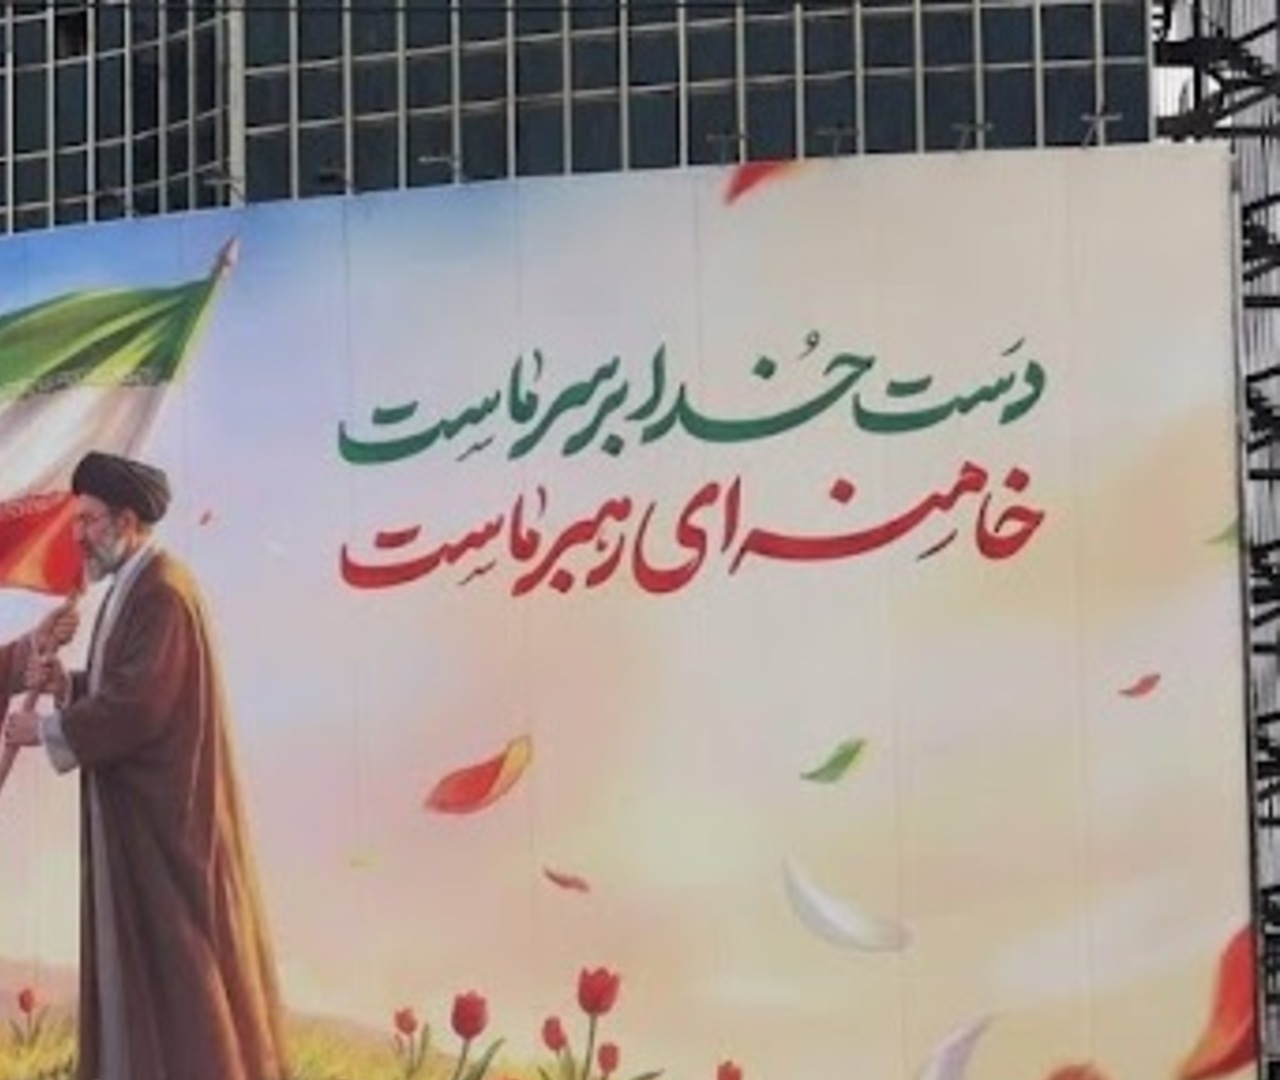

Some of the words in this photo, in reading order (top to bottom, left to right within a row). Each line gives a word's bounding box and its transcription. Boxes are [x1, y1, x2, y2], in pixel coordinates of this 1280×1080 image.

[507, 356, 621, 461] سر
[561, 380, 628, 457] بر
[511, 496, 632, 598] رهبر
